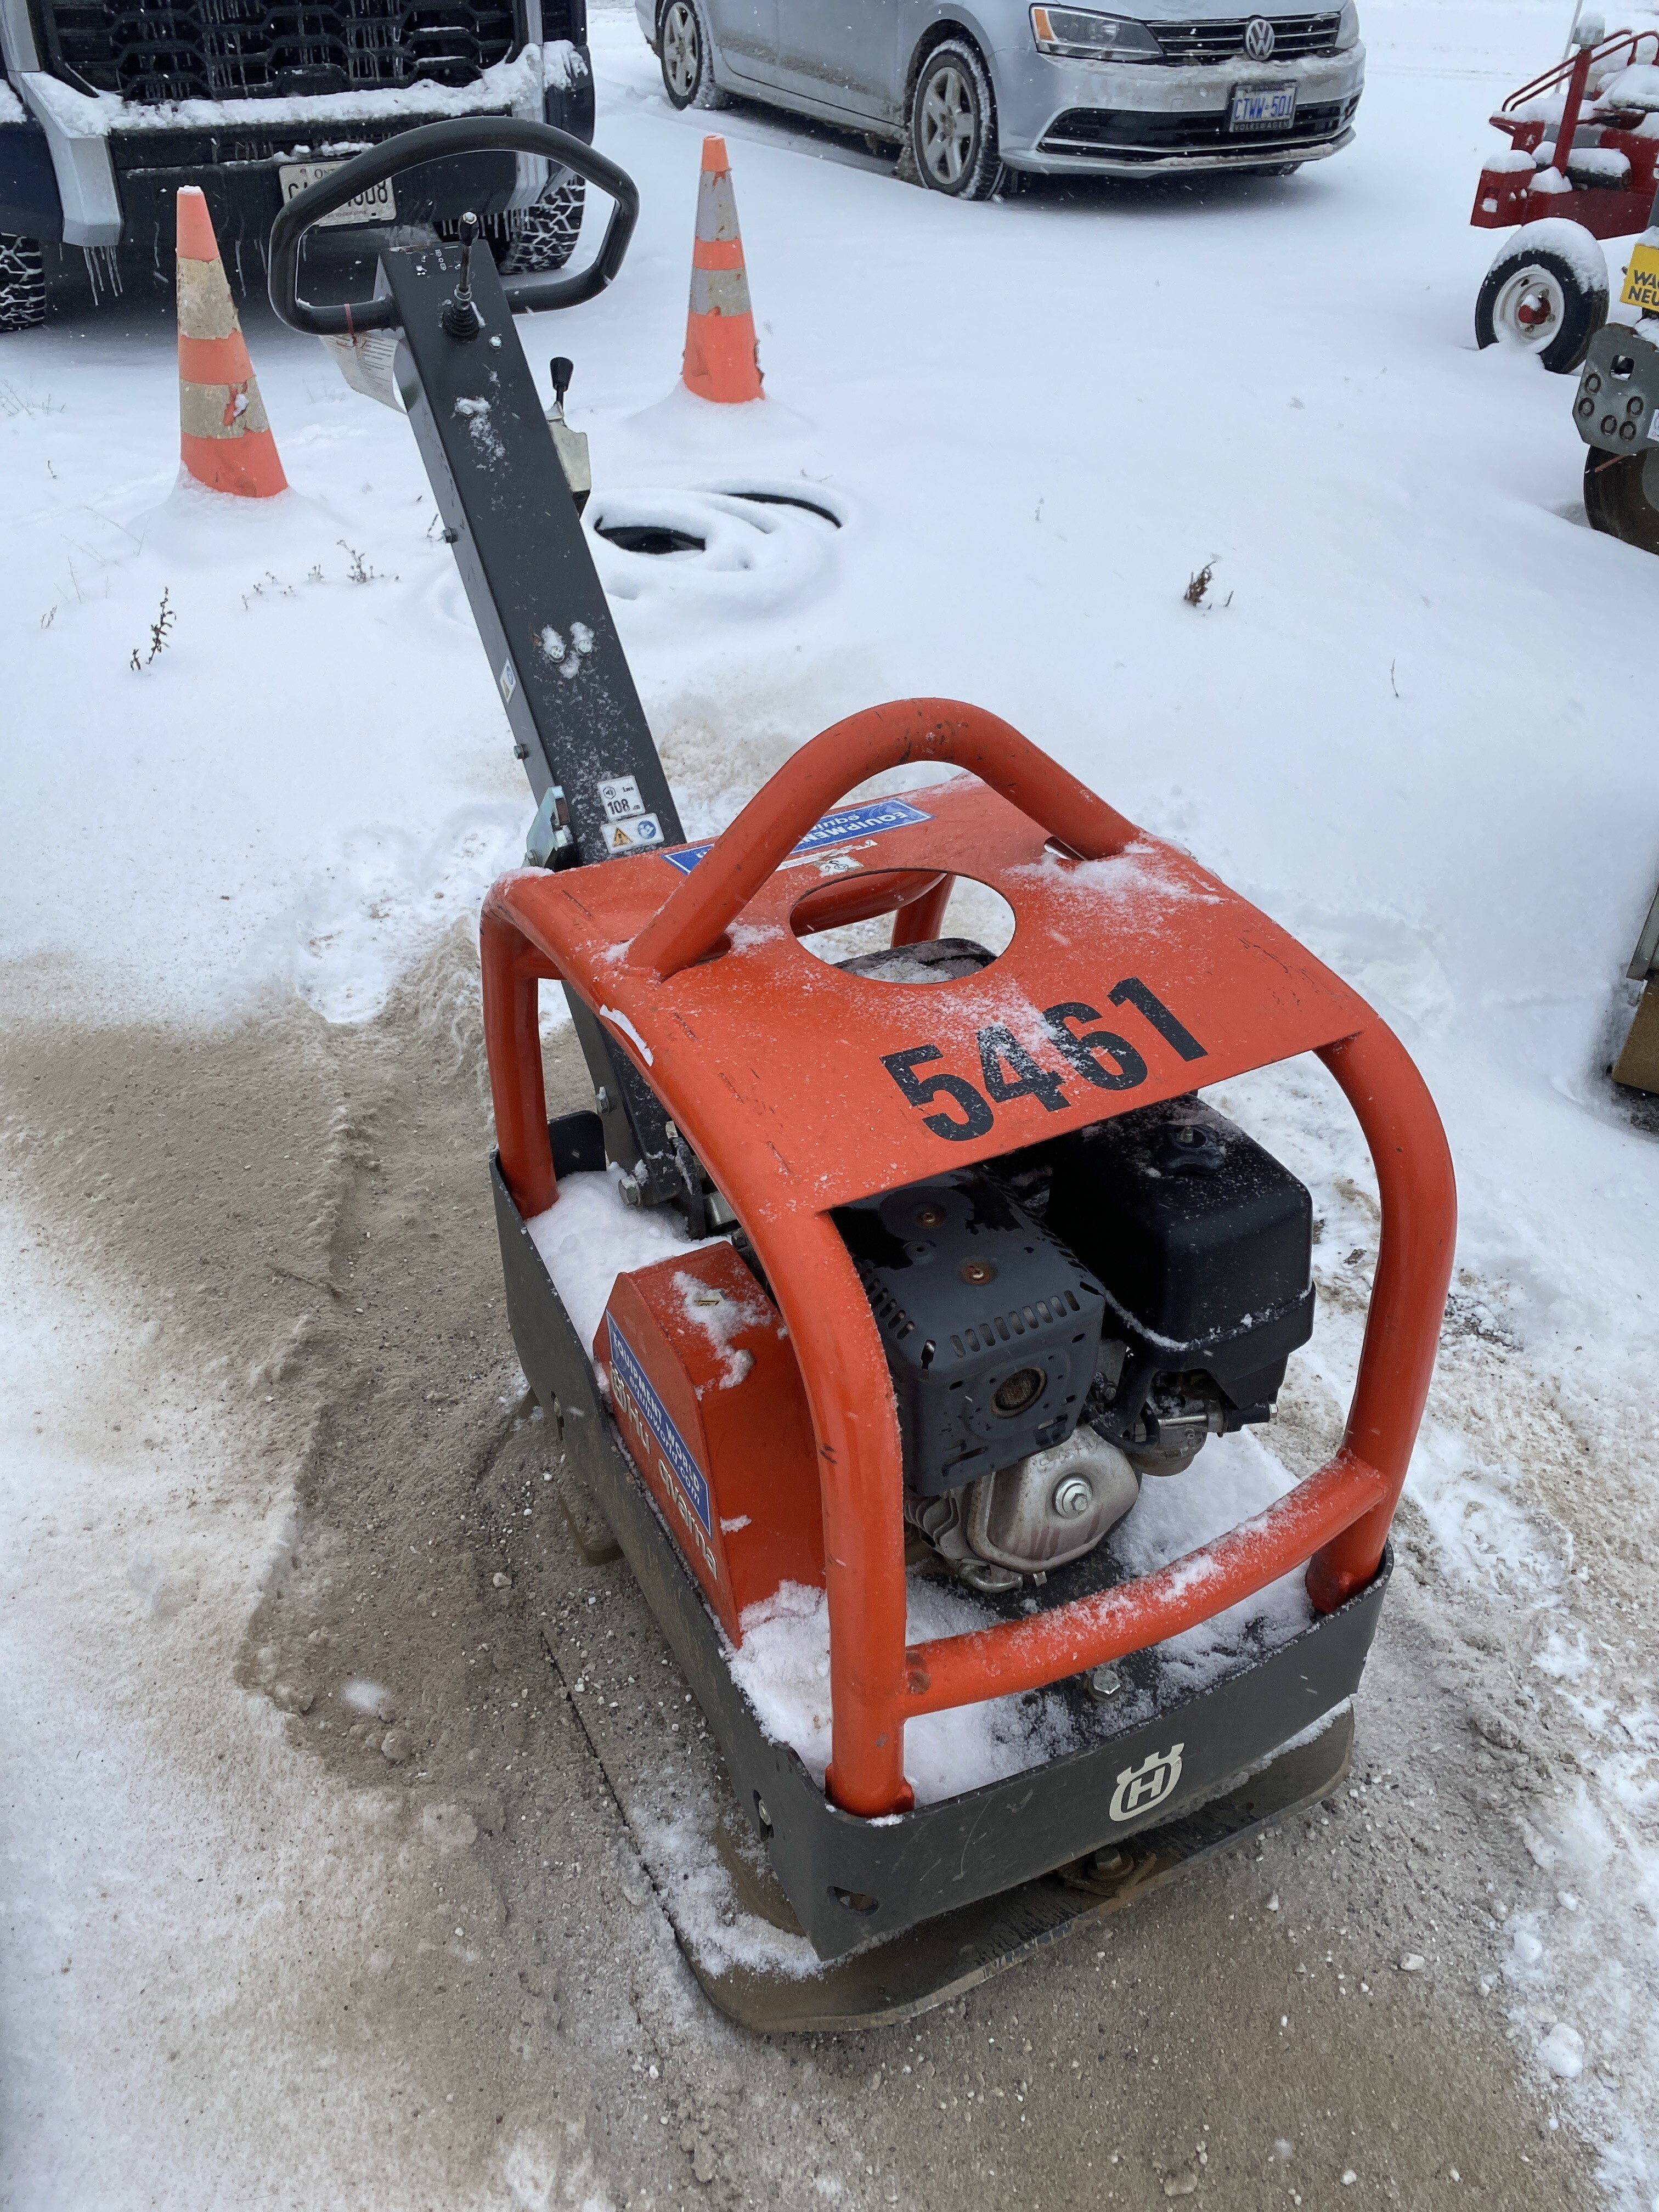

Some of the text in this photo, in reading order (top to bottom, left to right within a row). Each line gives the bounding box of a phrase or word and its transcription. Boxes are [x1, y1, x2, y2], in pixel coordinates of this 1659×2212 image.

[1634, 269, 1659, 289] WA
[607, 799, 630, 815] 108
[879, 977, 1209, 1141] 5461
[613, 1331, 701, 1492] EQUIPMENT WORLD
[629, 1376, 700, 1505] equipworld.com
